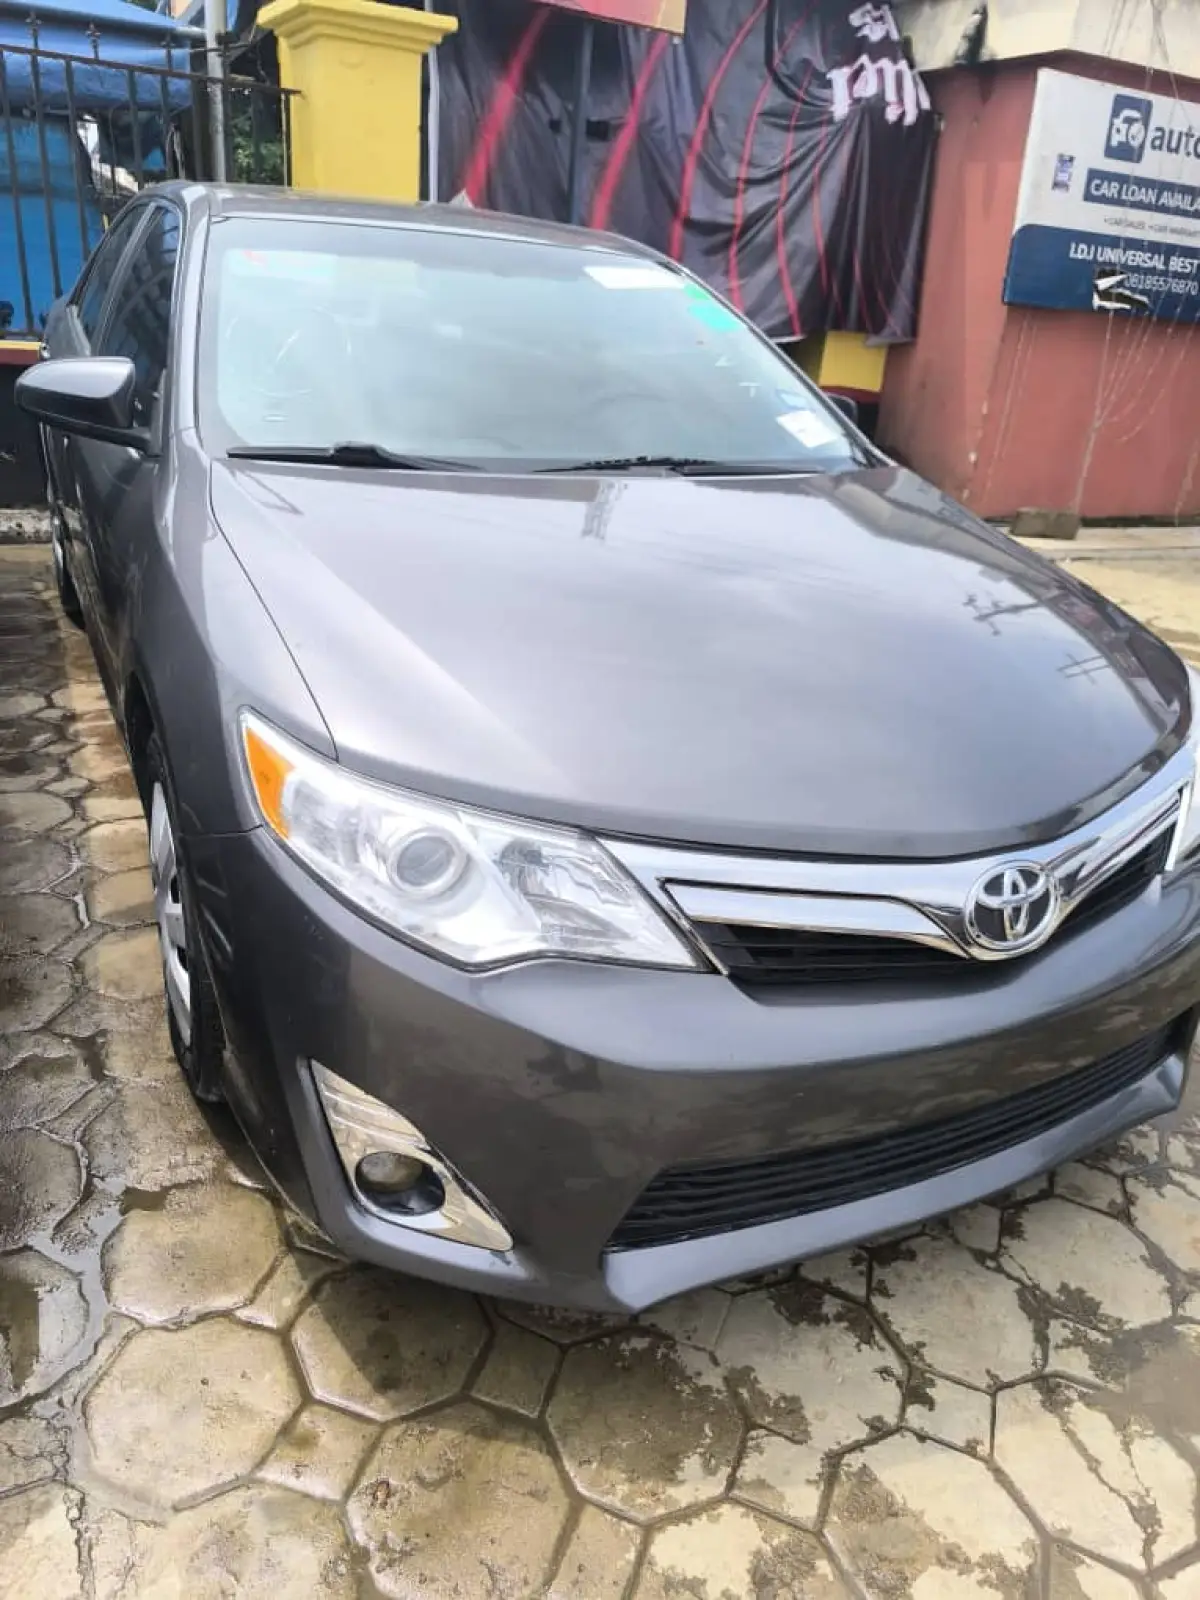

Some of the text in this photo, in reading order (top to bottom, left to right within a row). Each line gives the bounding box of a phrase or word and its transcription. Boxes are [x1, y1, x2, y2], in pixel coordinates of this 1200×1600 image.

[1091, 179, 1120, 199] CAR
[1120, 184, 1157, 205] LOAN
[1096, 245, 1166, 270] UNIVERSAL
[1168, 255, 1199, 273] BEST
